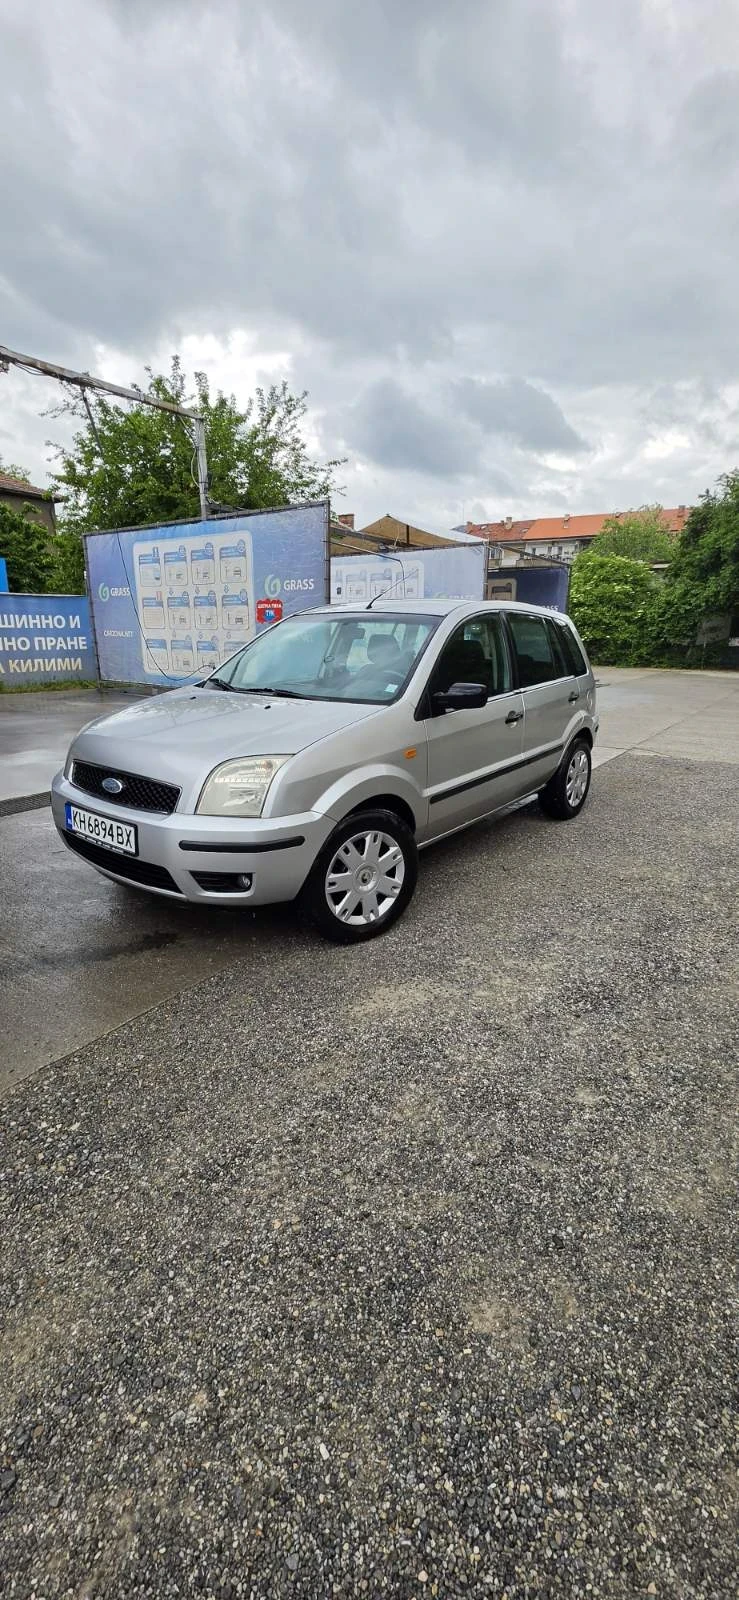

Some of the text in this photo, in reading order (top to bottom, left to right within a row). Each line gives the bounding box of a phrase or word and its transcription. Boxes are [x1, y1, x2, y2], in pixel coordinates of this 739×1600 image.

[283, 579, 314, 590] GRASS
[110, 587, 130, 597] GRASS
[70, 615, 80, 628] И
[33, 636, 87, 650] ПРАНЕ
[9, 658, 82, 673] КИЛИМИ
